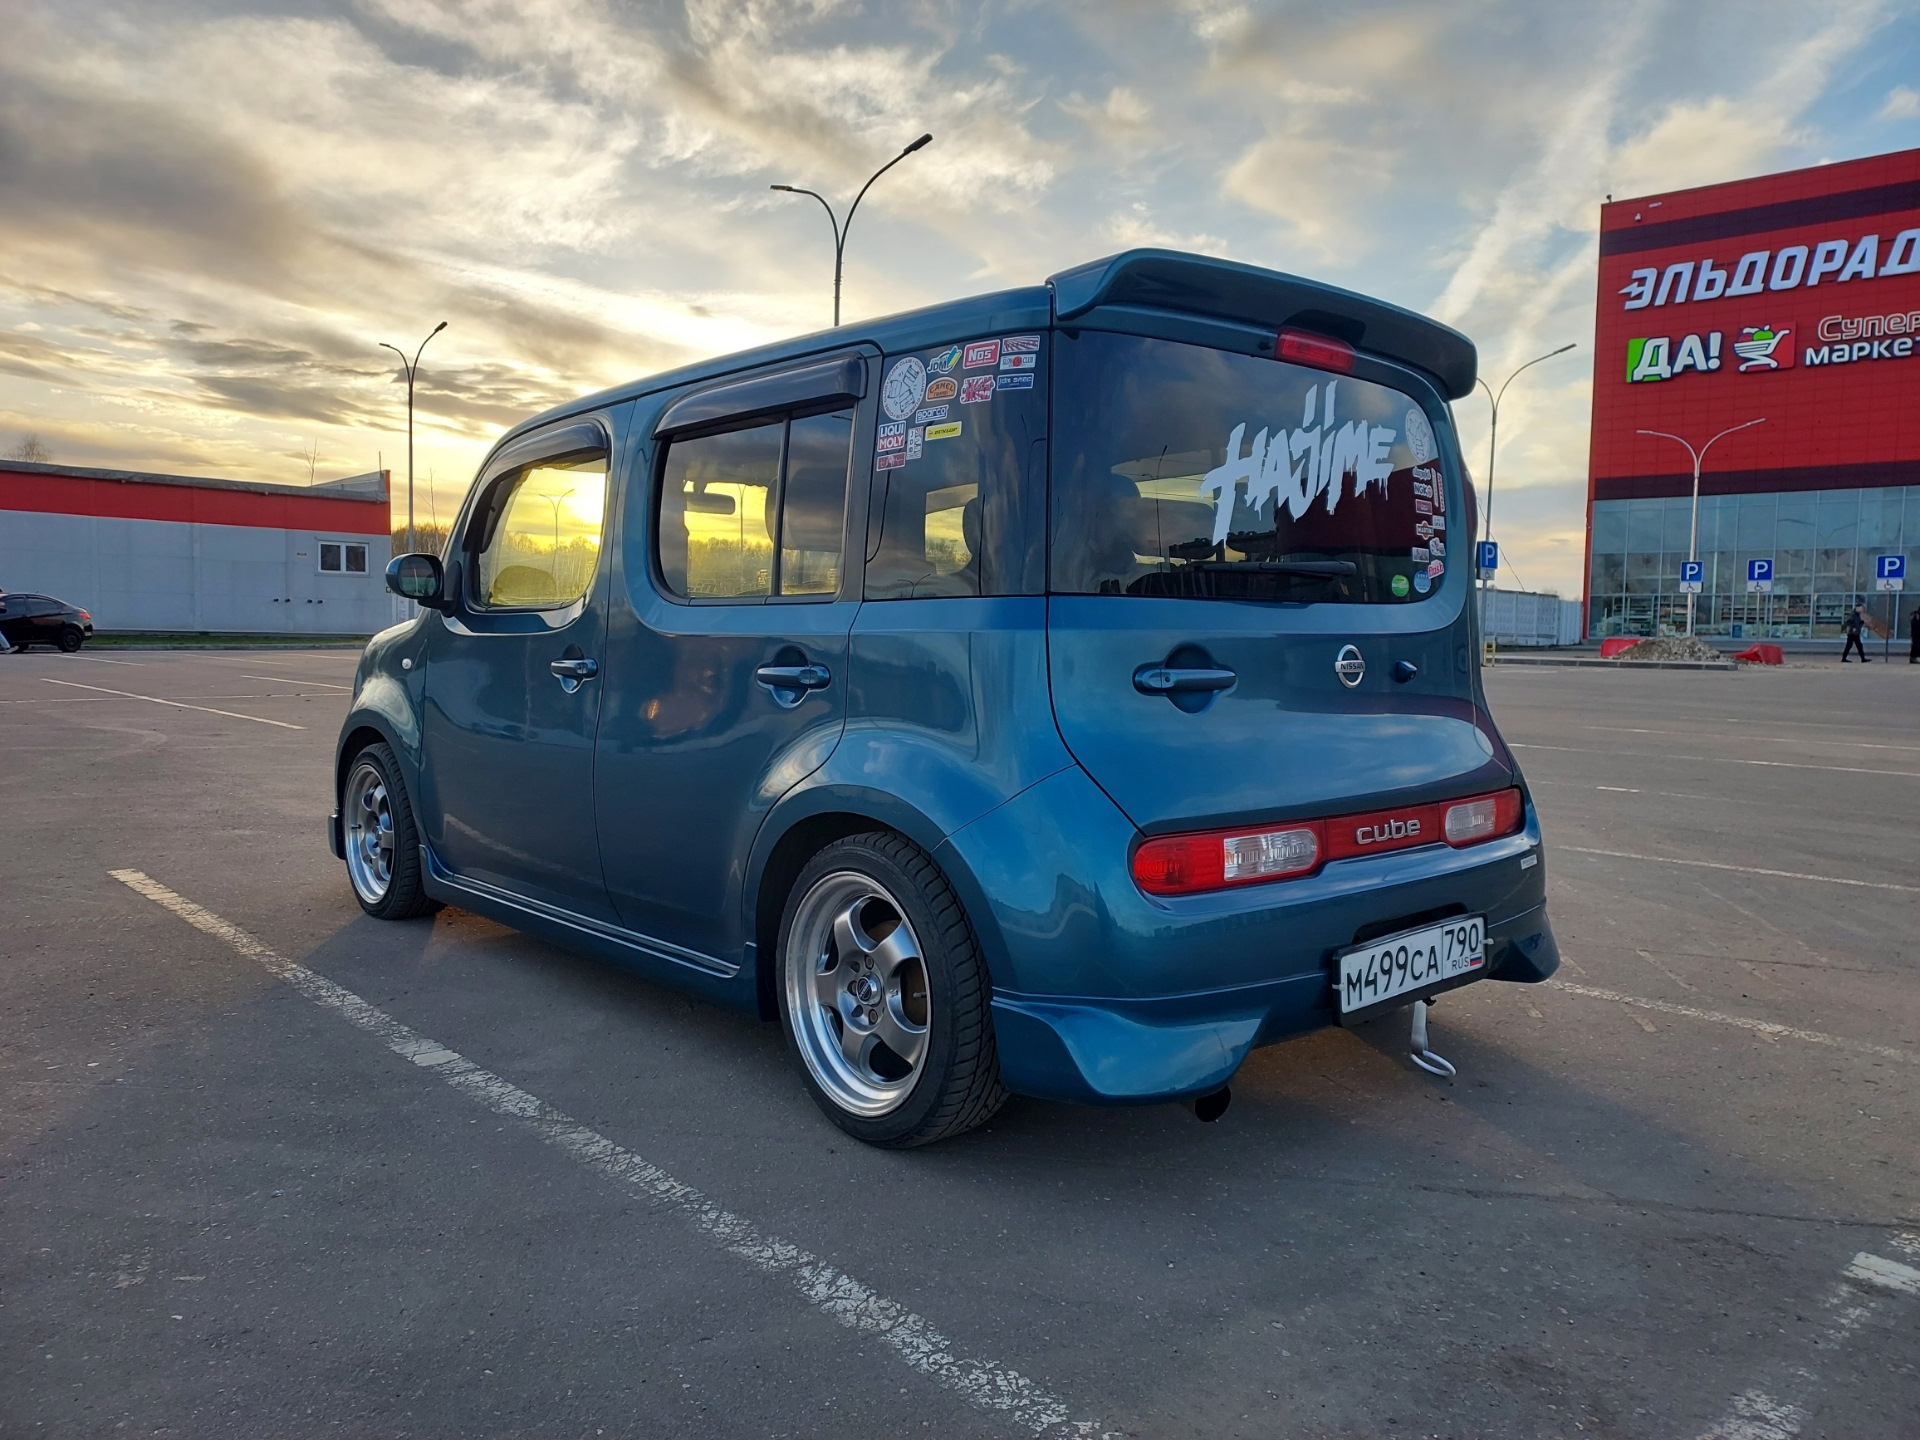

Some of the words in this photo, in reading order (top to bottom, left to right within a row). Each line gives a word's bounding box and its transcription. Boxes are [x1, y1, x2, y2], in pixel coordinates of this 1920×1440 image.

[1618, 228, 1920, 310] ЭЛЬДОРАД
[1818, 311, 1920, 342] Супер
[968, 349, 992, 362] NOS
[1631, 331, 1722, 381] ДА!
[1805, 336, 1920, 366] марке
[928, 357, 951, 372] JDM
[930, 381, 954, 394] CAMEL
[917, 408, 946, 419] sparco
[880, 423, 904, 437] LIQUI
[879, 435, 904, 450] MOLY
[1199, 380, 1397, 549] HAJIME
[1414, 483, 1427, 496] NGK
[1485, 544, 1495, 566] P
[1686, 563, 1699, 579] P
[1754, 560, 1769, 579] P
[1884, 557, 1900, 576] P
[1356, 818, 1421, 845] cube
[1444, 923, 1479, 961] 790
[1452, 956, 1469, 971] RUS
